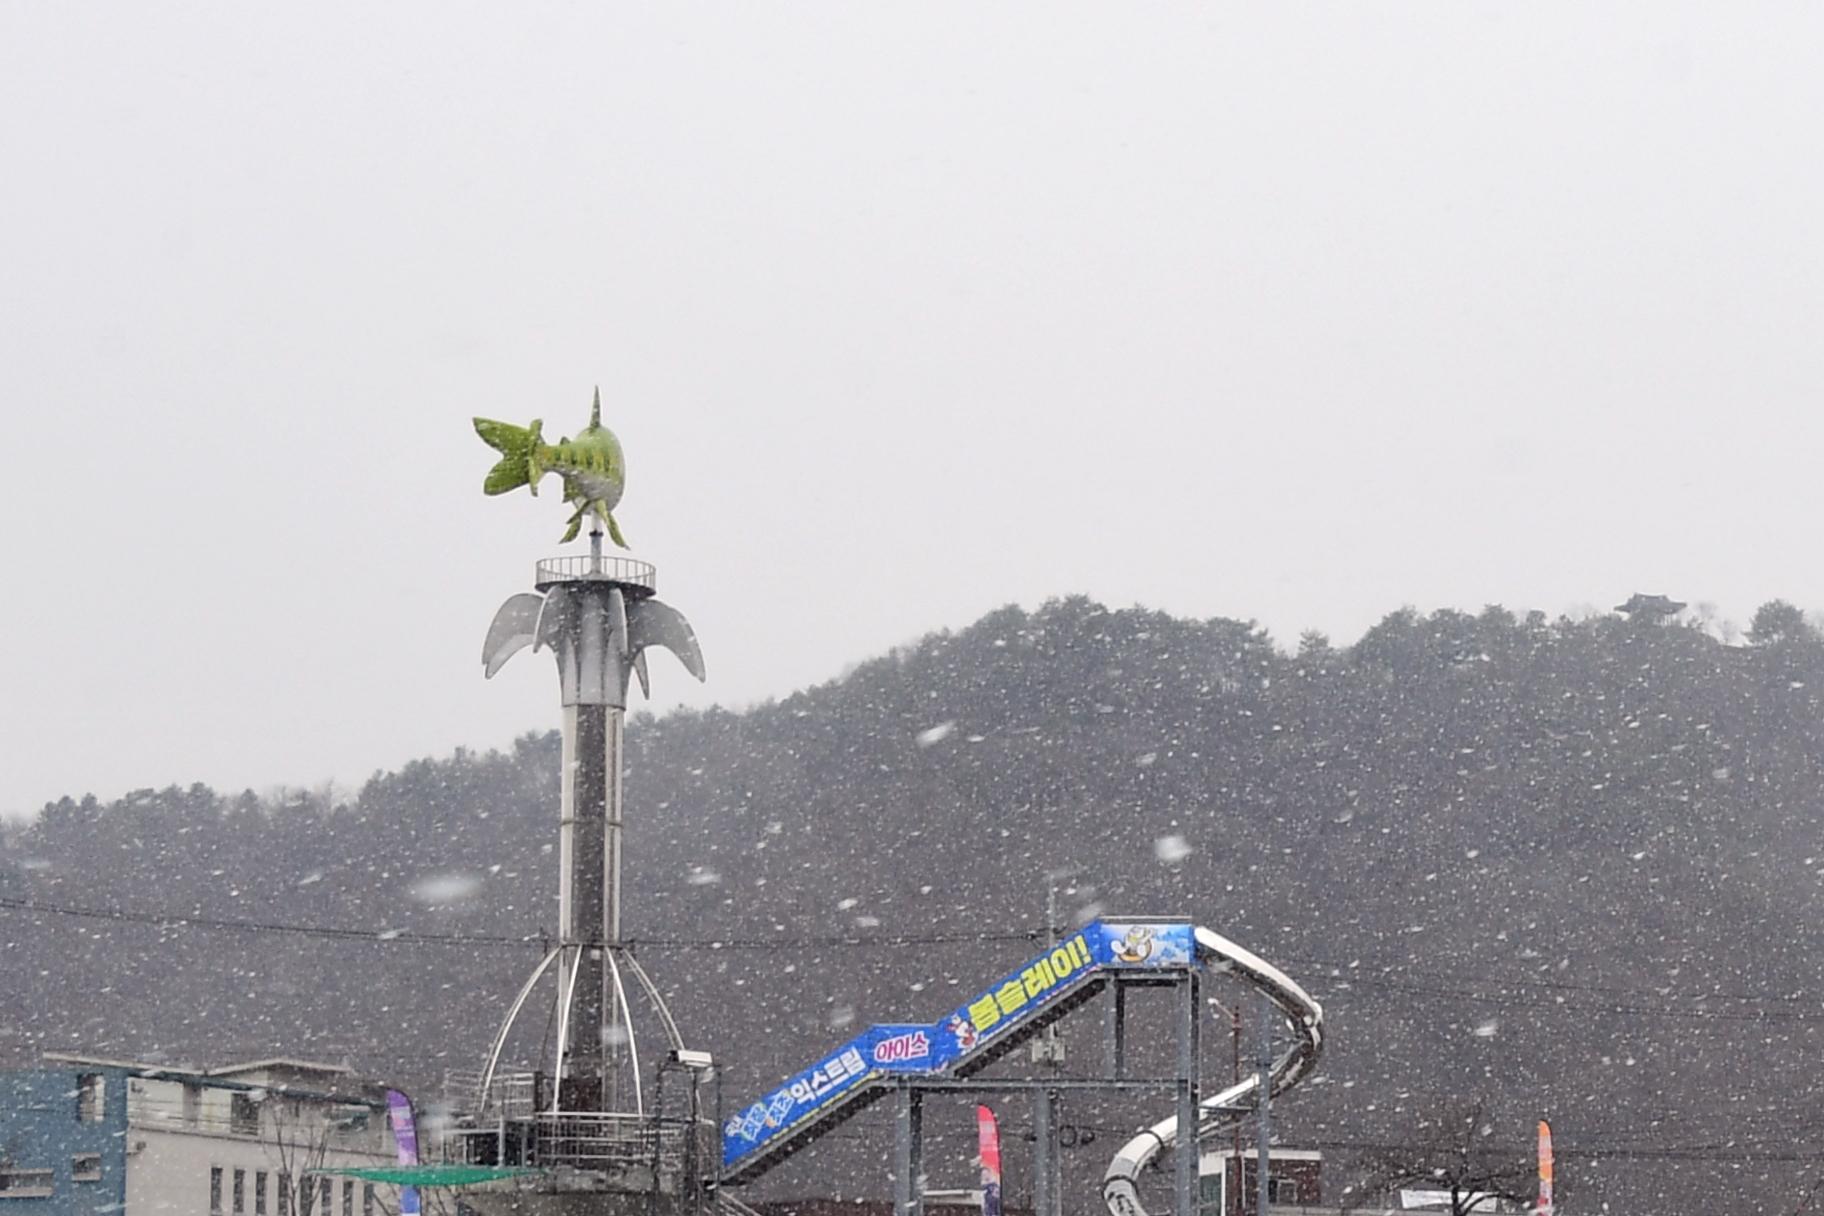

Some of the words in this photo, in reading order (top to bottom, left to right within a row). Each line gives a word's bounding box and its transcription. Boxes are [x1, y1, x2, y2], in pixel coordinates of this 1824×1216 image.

[790, 1047, 867, 1105] 익스트림
[874, 1031, 930, 1063] 아이스
[968, 934, 1092, 1033] 봅슬레이!
